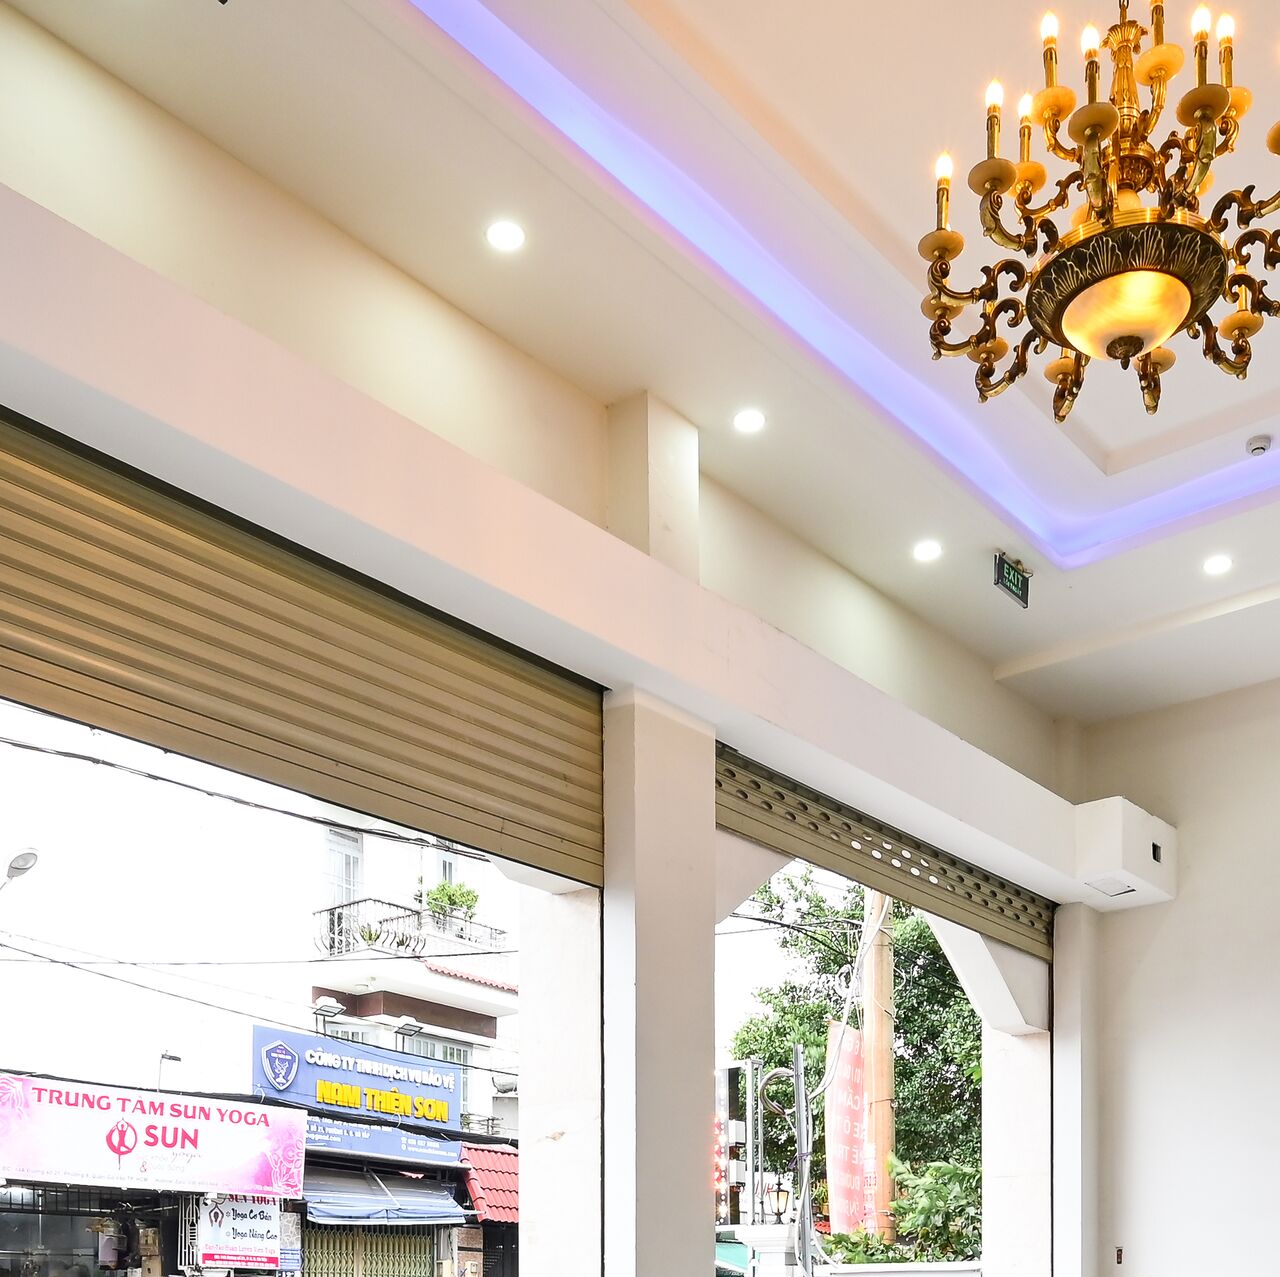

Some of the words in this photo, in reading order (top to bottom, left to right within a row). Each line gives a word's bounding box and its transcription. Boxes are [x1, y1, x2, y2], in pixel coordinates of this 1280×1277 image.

[1003, 563, 1023, 588] EXIT
[305, 1046, 341, 1070] CÔNG
[341, 1055, 356, 1072] TY
[31, 1086, 111, 1110] TRUNG
[169, 1103, 212, 1122] SUN
[216, 1107, 271, 1128] YOGA
[316, 1079, 362, 1109] NAM
[144, 1124, 199, 1150] SUN
